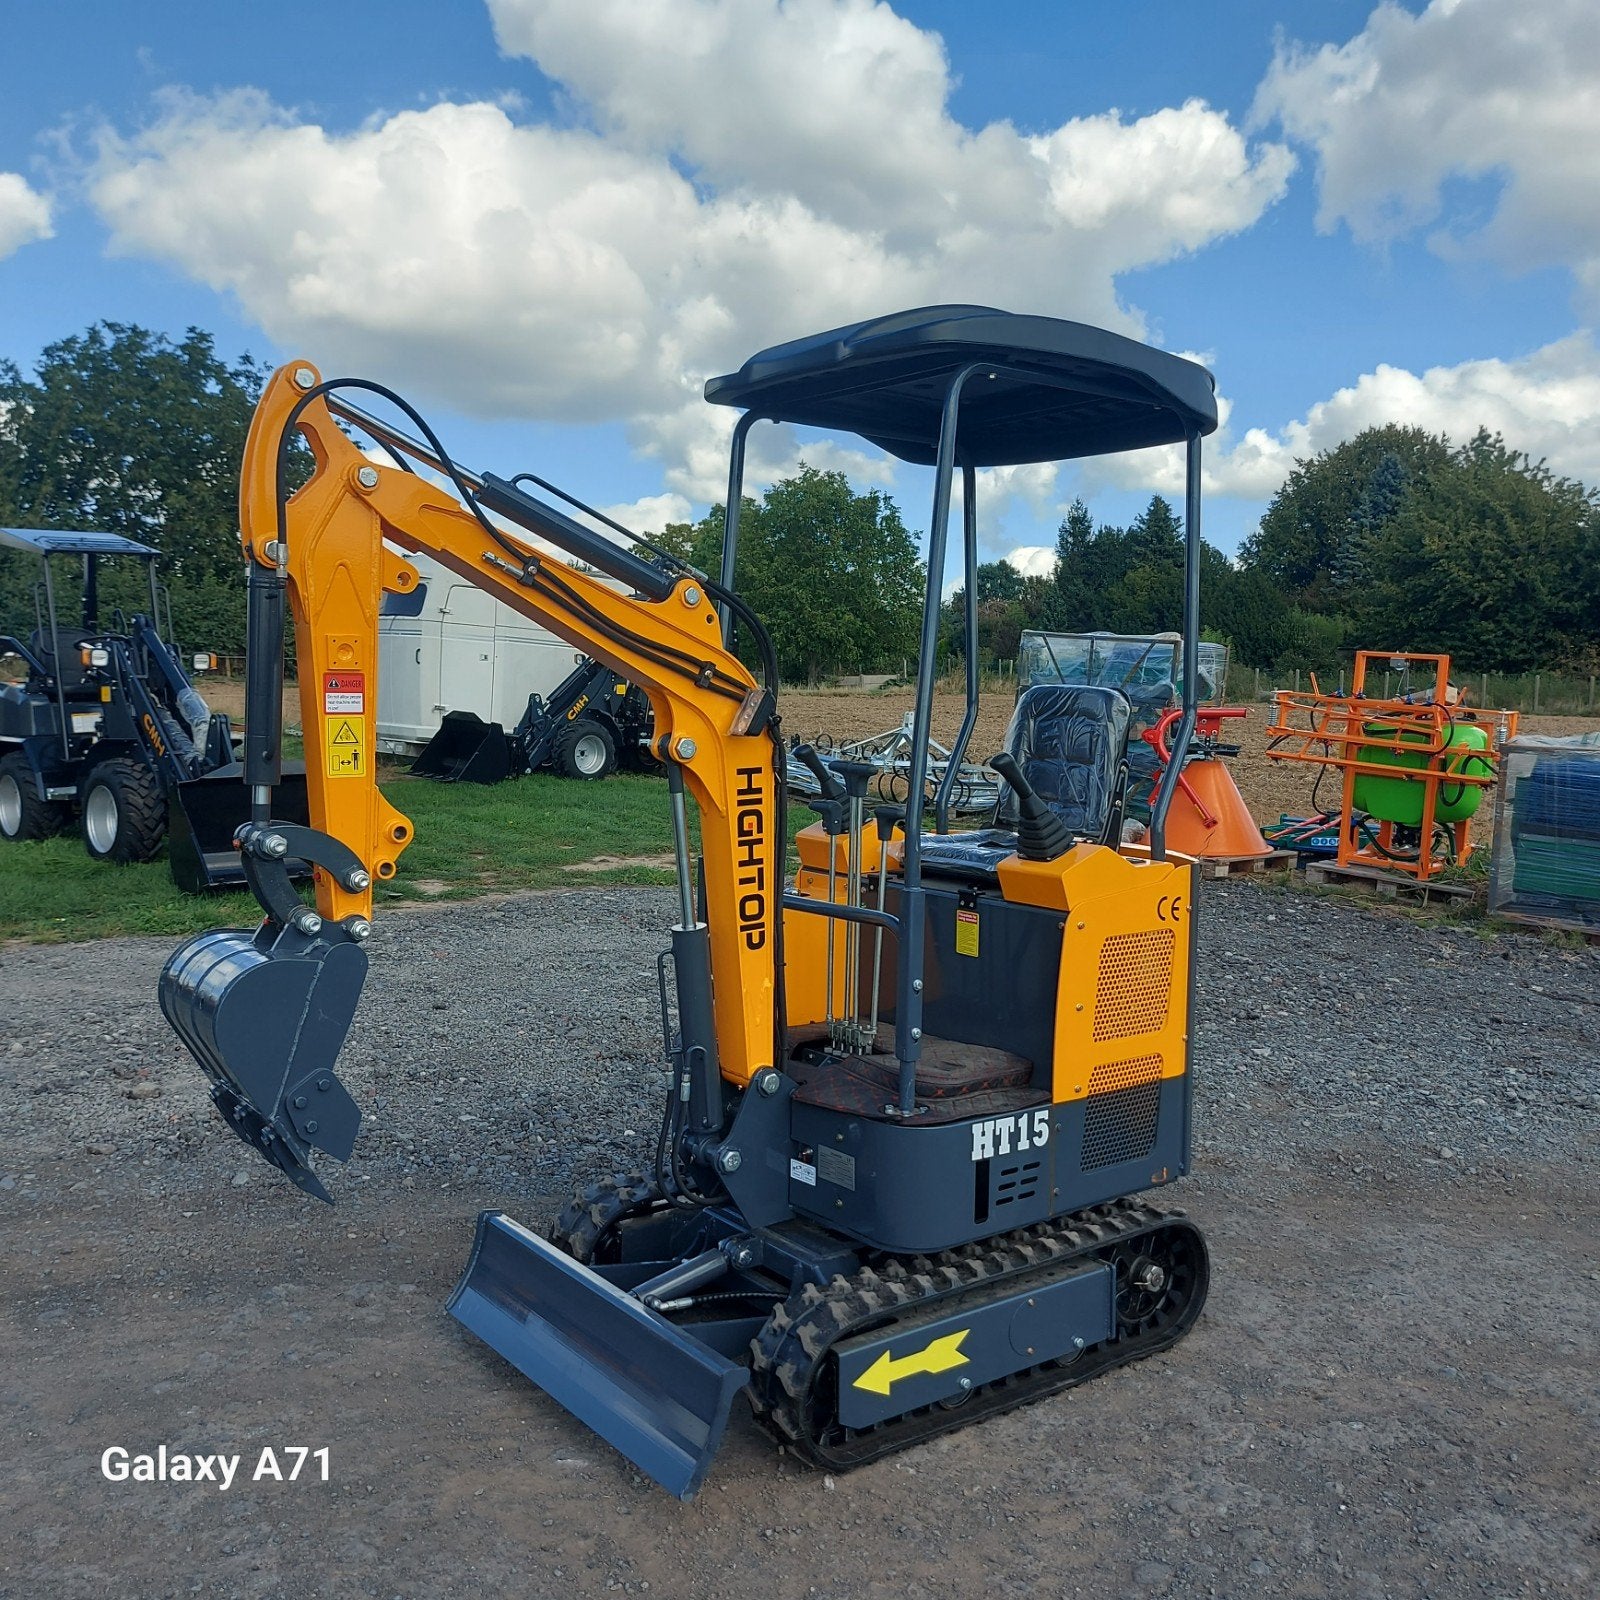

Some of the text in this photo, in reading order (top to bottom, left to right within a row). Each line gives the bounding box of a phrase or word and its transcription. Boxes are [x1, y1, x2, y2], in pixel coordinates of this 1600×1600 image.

[340, 679, 362, 688] DANGER
[566, 694, 589, 720] CMH
[143, 713, 165, 757] CMH
[736, 766, 766, 951] HIGHTOP
[1157, 895, 1182, 922] CE
[971, 1109, 1050, 1161] HT15
